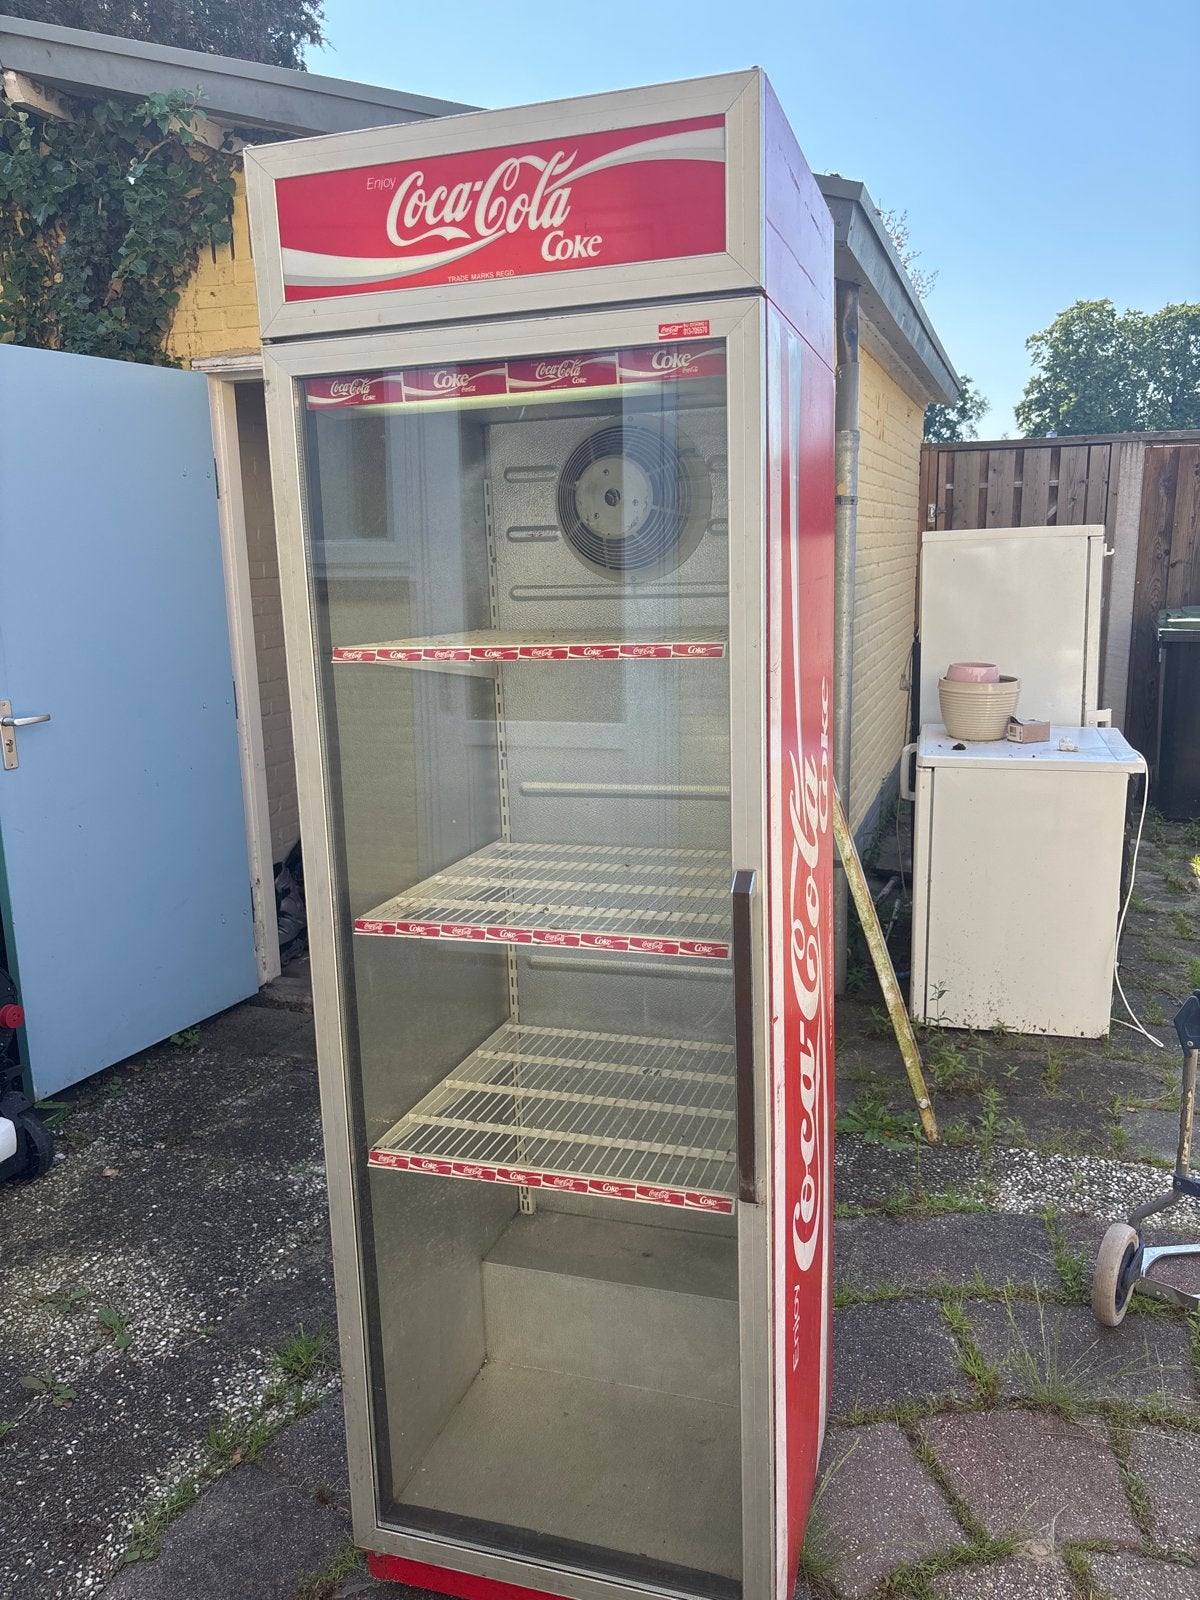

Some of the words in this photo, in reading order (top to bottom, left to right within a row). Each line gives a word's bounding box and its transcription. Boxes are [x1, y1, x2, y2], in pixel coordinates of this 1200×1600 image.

[366, 175, 396, 191] Enjoy
[386, 149, 578, 247] Coca-Cola
[541, 230, 603, 262] Coke
[447, 274, 469, 283] TRADE
[470, 271, 495, 281] MARKS
[535, 359, 581, 380] Coca-Cola
[651, 350, 691, 369] Coke
[330, 377, 371, 397] Coca-Cola
[433, 370, 469, 389] Coke
[390, 651, 407, 659] Coke
[484, 649, 502, 657] Coke
[584, 647, 601, 655] Coke
[688, 645, 706, 653] Coke
[816, 676, 829, 834] Coke
[500, 930, 517, 938] Coke
[595, 937, 612, 945] Coke
[695, 944, 712, 952] Coke
[790, 749, 823, 1272] Coca-Cola
[422, 1160, 438, 1169] Coke
[510, 1172, 526, 1180] Coke
[602, 1183, 619, 1192] Coke
[700, 1195, 717, 1206] Coke
